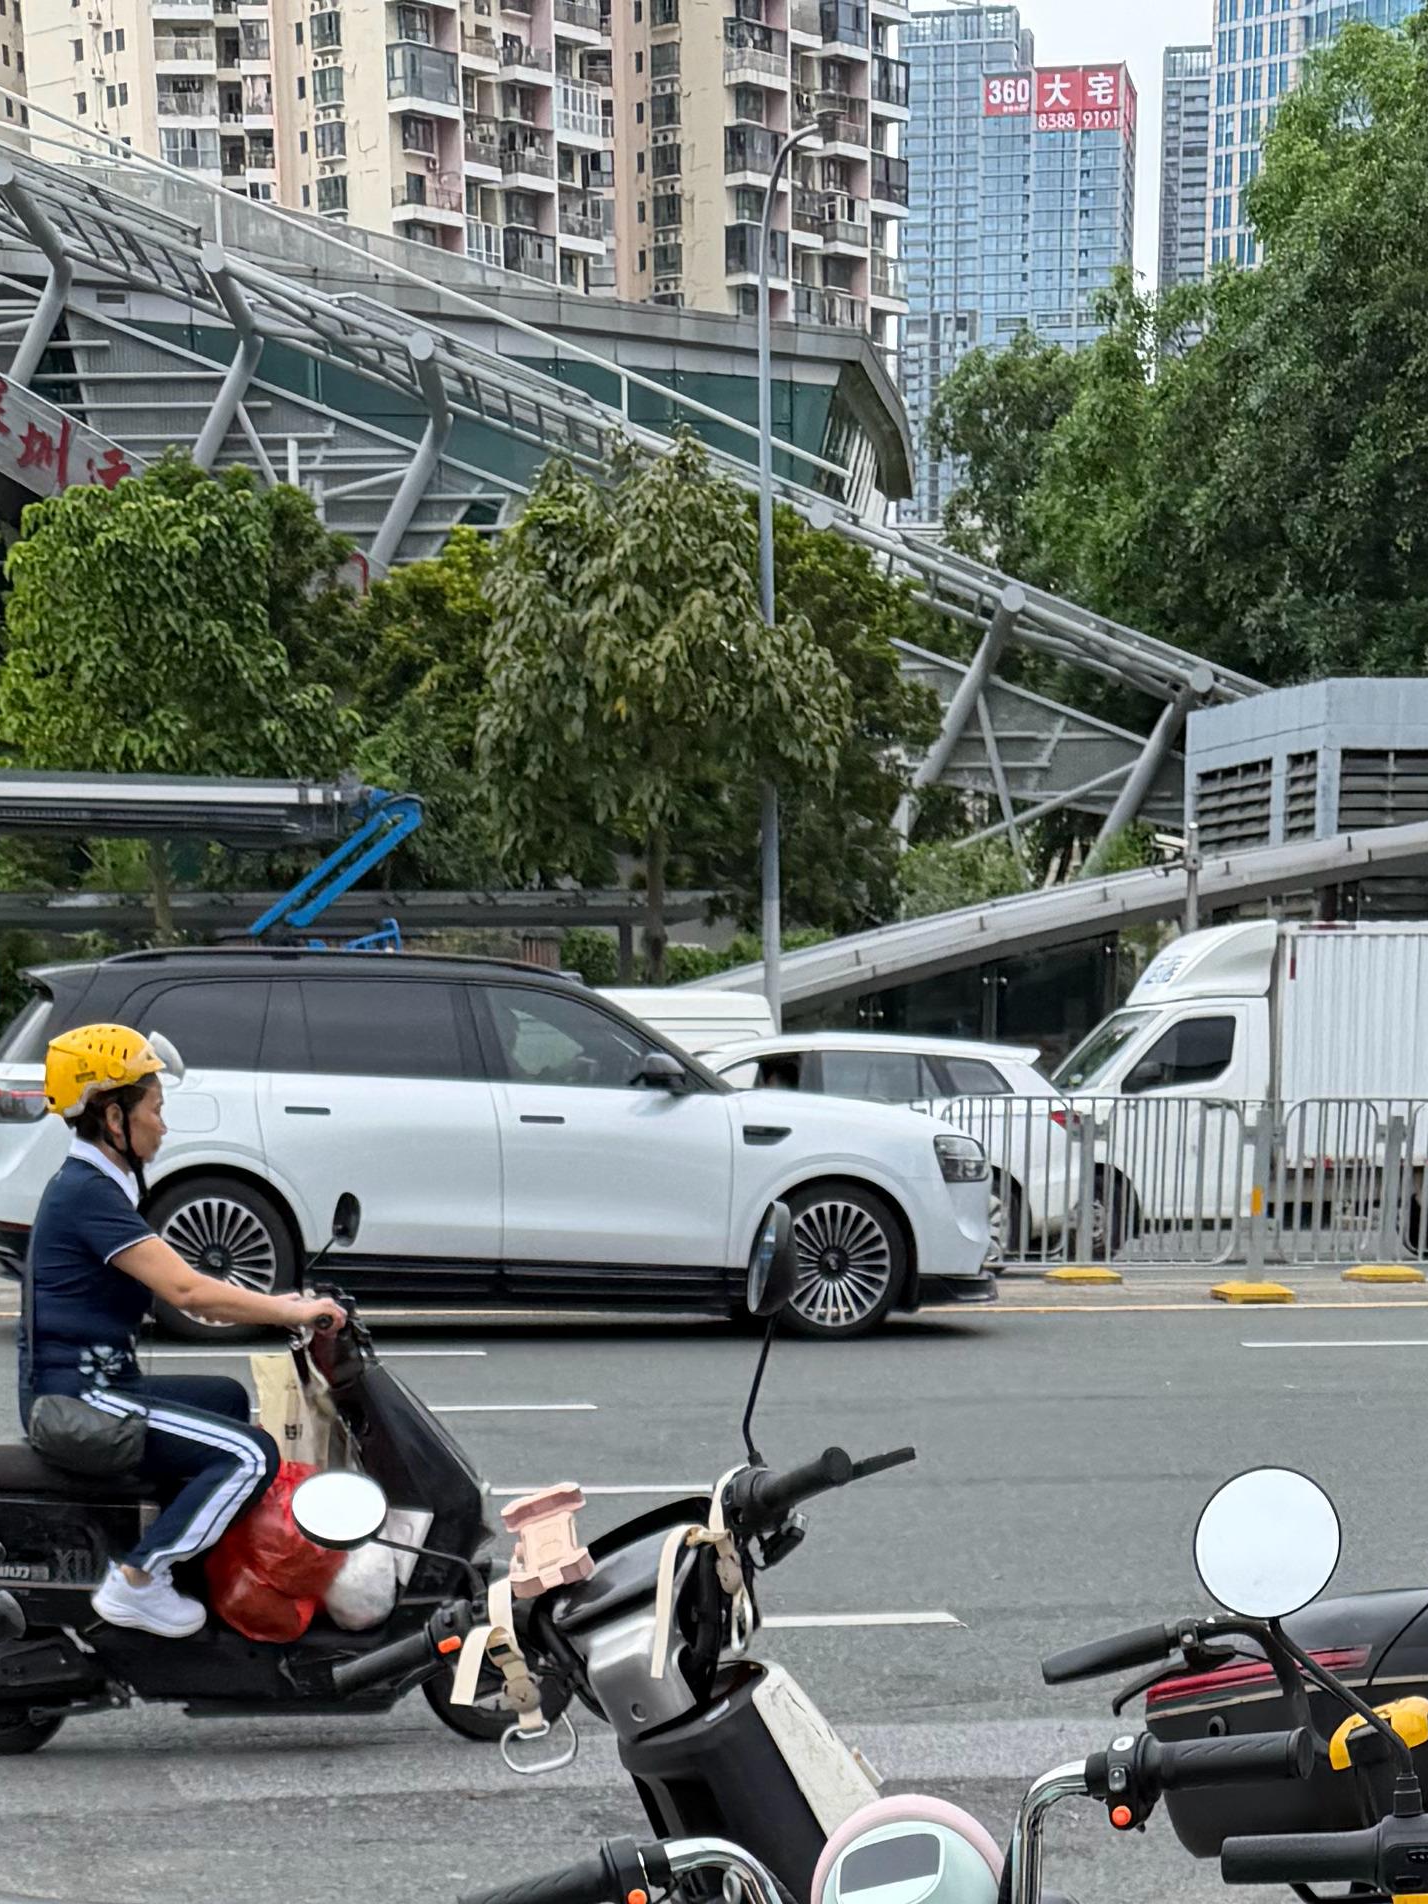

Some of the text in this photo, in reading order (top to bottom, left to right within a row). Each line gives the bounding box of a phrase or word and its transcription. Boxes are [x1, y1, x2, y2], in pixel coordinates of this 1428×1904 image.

[988, 72, 1115, 108] 360 大宅
[1038, 110, 1118, 129] 8388 9191
